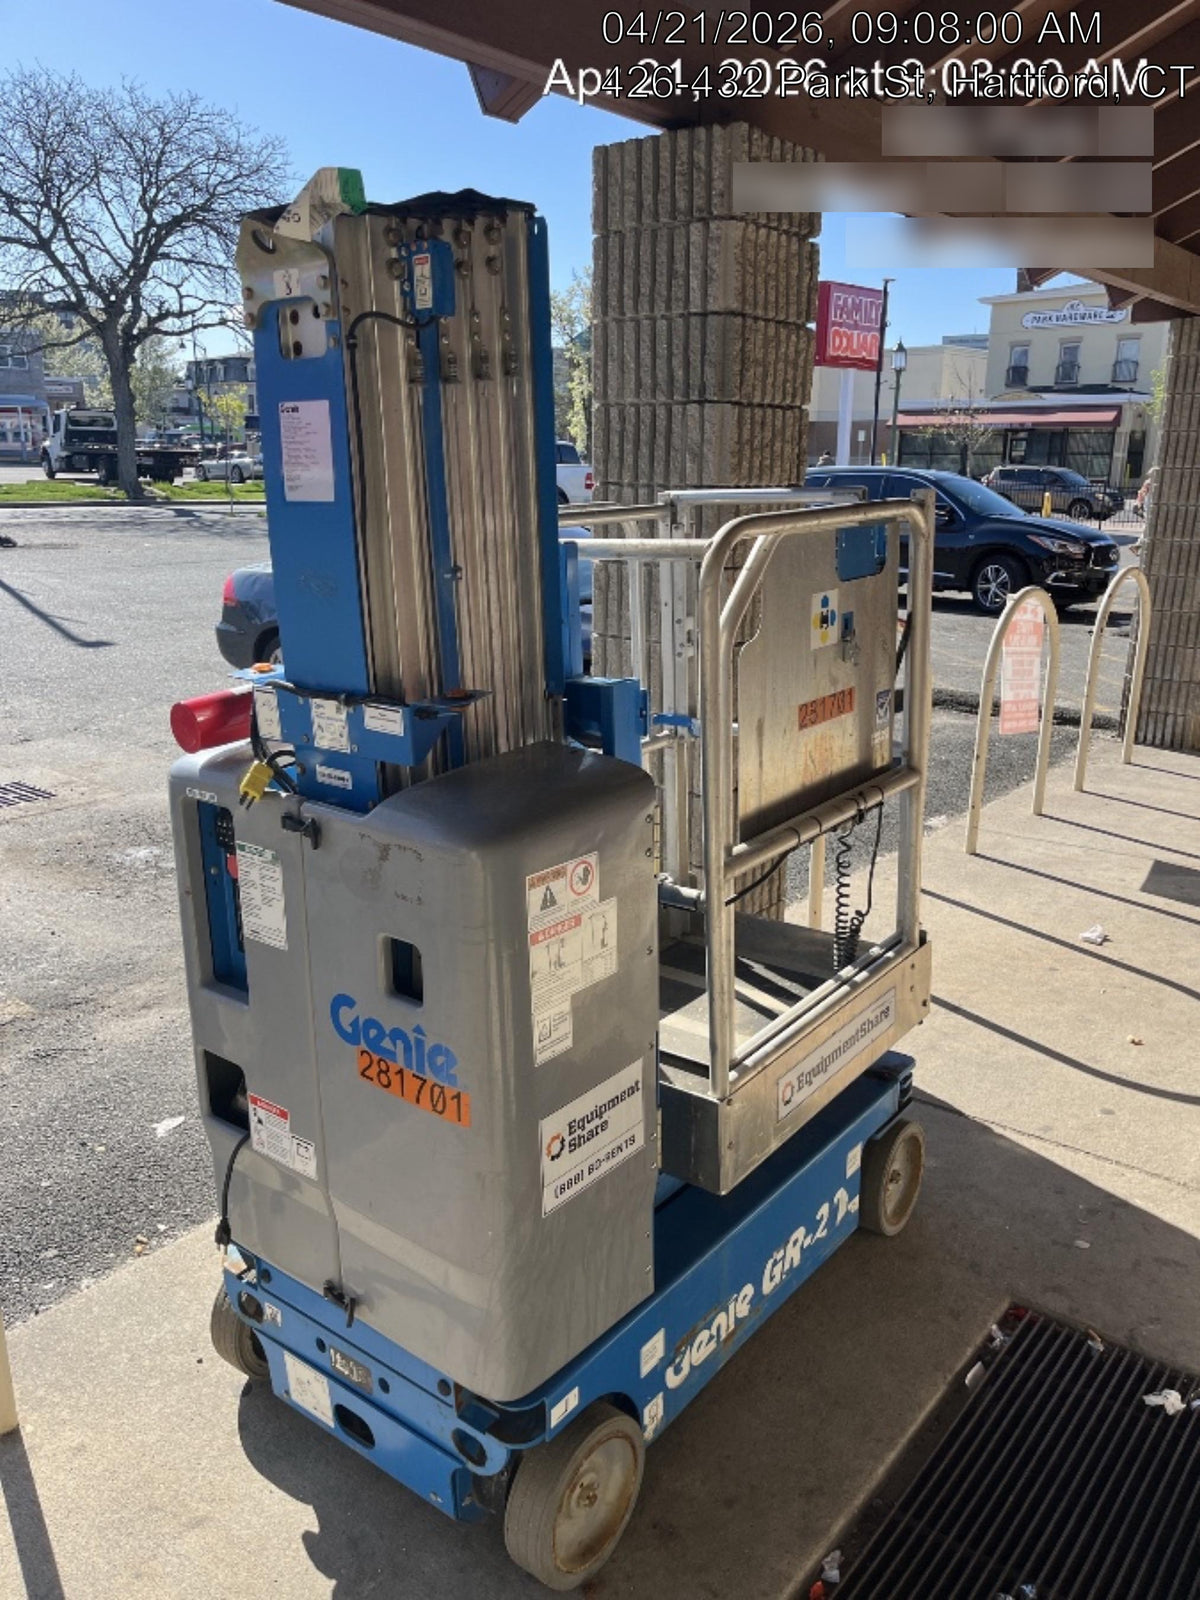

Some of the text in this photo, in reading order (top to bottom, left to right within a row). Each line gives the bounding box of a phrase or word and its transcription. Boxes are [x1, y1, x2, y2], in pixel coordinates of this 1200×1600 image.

[832, 292, 884, 328] FAMILY
[830, 326, 880, 360] DOLLAR
[330, 993, 458, 1088] Genie
[796, 1005, 890, 1093] EquipmentShare
[360, 1050, 462, 1122] 281701
[568, 1079, 640, 1137] Equipment
[568, 1118, 609, 1154] Share
